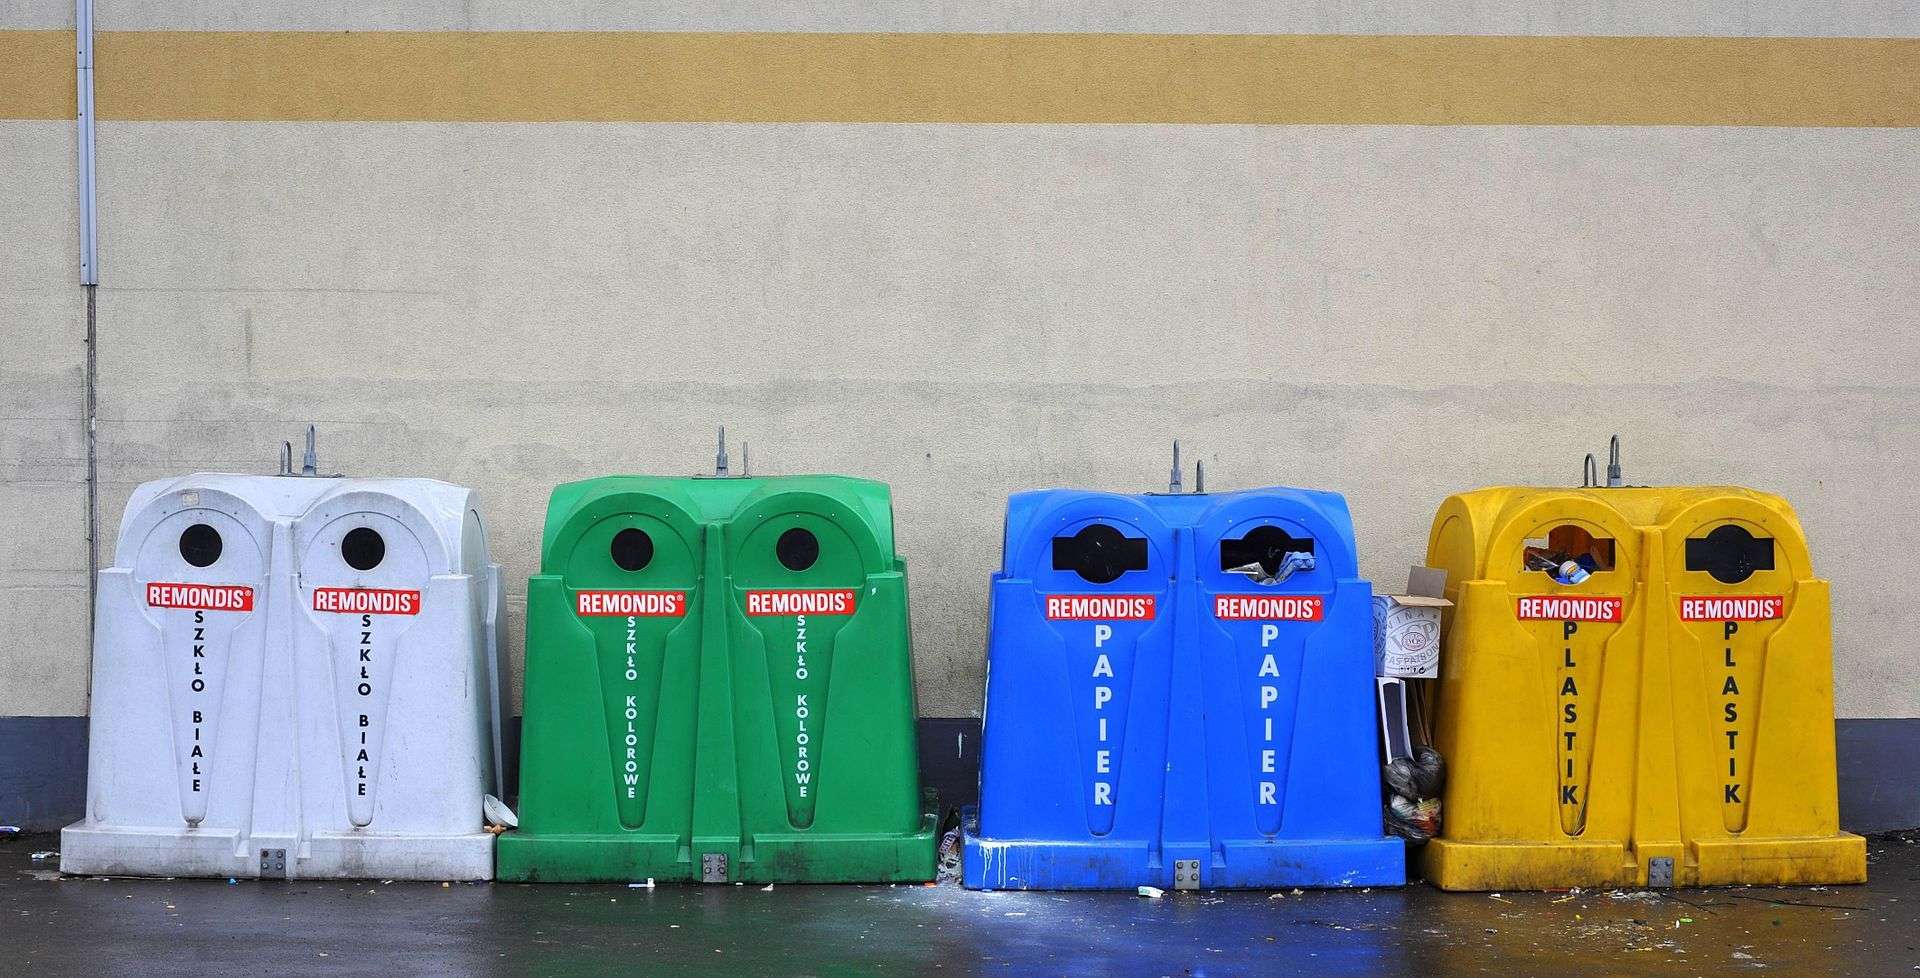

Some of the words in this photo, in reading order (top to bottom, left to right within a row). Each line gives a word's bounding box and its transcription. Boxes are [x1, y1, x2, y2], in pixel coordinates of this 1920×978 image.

[192, 610, 205, 693] SZKŁO
[358, 614, 372, 696] SZKŁO
[625, 615, 638, 681] SZKŁO
[796, 614, 809, 680] SZKŁO
[191, 710, 203, 792] BIAŁE
[356, 714, 369, 796] BIAŁE
[624, 695, 639, 799] KOLOROWE
[795, 694, 811, 798] KOLOROWE
[1092, 623, 1114, 806] PAPIER
[1258, 624, 1281, 805] PAPIER
[1560, 620, 1579, 805] PLASTIK
[1721, 620, 1741, 804] PLASTIK
